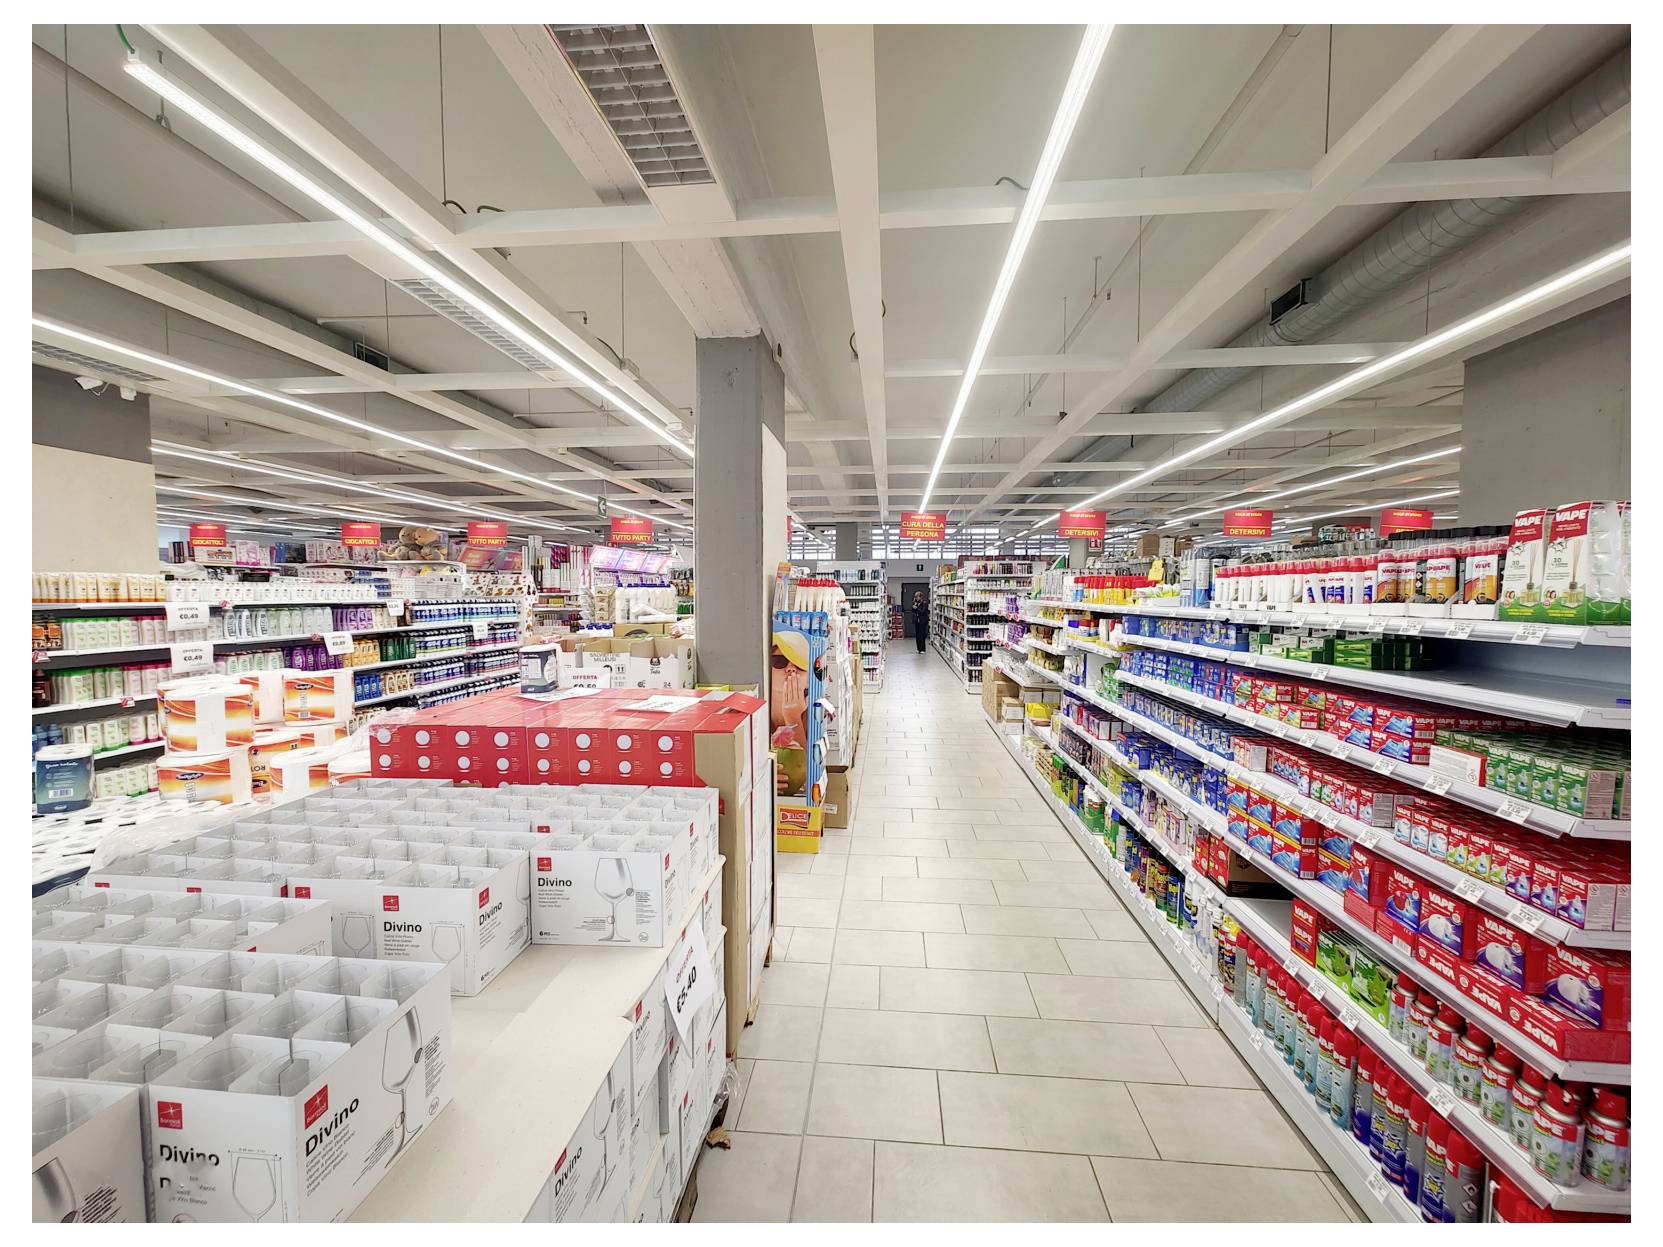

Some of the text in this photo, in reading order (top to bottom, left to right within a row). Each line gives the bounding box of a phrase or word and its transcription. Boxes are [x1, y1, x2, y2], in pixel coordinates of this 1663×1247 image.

[1514, 515, 1543, 527] VAPE
[1555, 509, 1588, 522] VAPE
[901, 520, 945, 529] CURA DELLA
[1229, 528, 1266, 536] DETERSIVI
[906, 530, 940, 538] PERSONA
[1064, 528, 1099, 537] DETERSIVI
[192, 538, 224, 547] GIOCATTOLI
[345, 538, 378, 546] GIOCATTOLI
[1488, 746, 1509, 757] VAPE
[1509, 751, 1532, 763] VAPE
[1533, 757, 1557, 770] VAPE
[1560, 764, 1586, 778] VAPE
[1396, 806, 1412, 817] VAPE
[1414, 812, 1430, 824] VAPE
[1431, 819, 1448, 832] VAPE
[1450, 826, 1468, 840] VAPE
[1470, 834, 1491, 847] VAPE
[1353, 849, 1368, 865] VAPE
[1509, 852, 1532, 868] VAPE
[1534, 862, 1557, 877] VAPE
[538, 877, 573, 887] Divino
[1393, 870, 1415, 889] VAPE
[1562, 873, 1586, 890] VAPE
[1428, 891, 1456, 911] VAPE
[480, 901, 503, 926] Divino
[1294, 905, 1314, 924] VAPE
[384, 921, 423, 933] Divino
[1294, 924, 1313, 944] VAPE
[1484, 917, 1515, 941] VAPE
[1556, 946, 1592, 974] VAPE
[1429, 958, 1456, 981] VAPE
[1471, 987, 1503, 1014] VAPE
[1522, 1021, 1559, 1052] VAPE
[1481, 1064, 1509, 1087] APE
[305, 1097, 360, 1158] Divino
[1533, 1108, 1565, 1137] APE
[1585, 1120, 1619, 1143] APE
[160, 1144, 220, 1167] Divino
[554, 1146, 583, 1198] Divino
